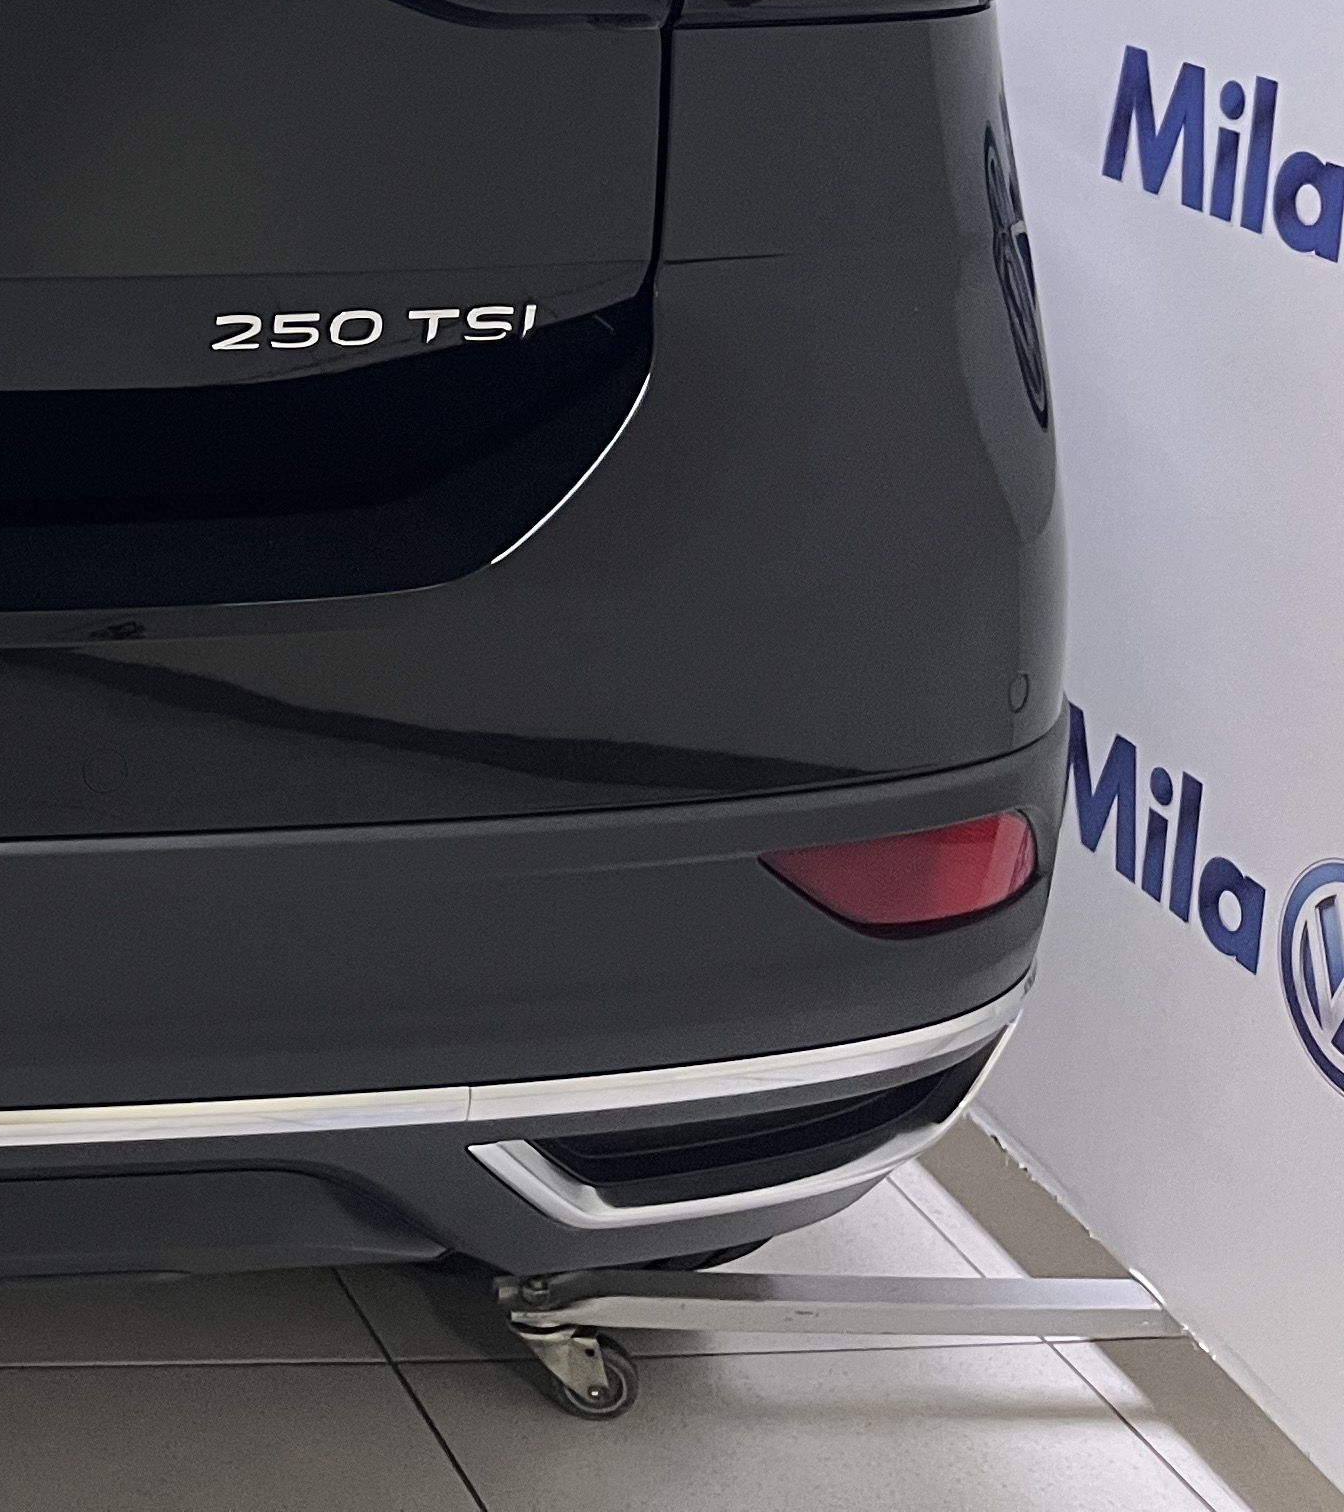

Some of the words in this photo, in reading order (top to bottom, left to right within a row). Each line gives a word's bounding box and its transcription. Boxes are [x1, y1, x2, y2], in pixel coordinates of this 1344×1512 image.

[1102, 44, 1344, 263] Mila
[211, 309, 384, 351] 250
[408, 304, 538, 344] TSI
[1068, 701, 1267, 976] Mila
